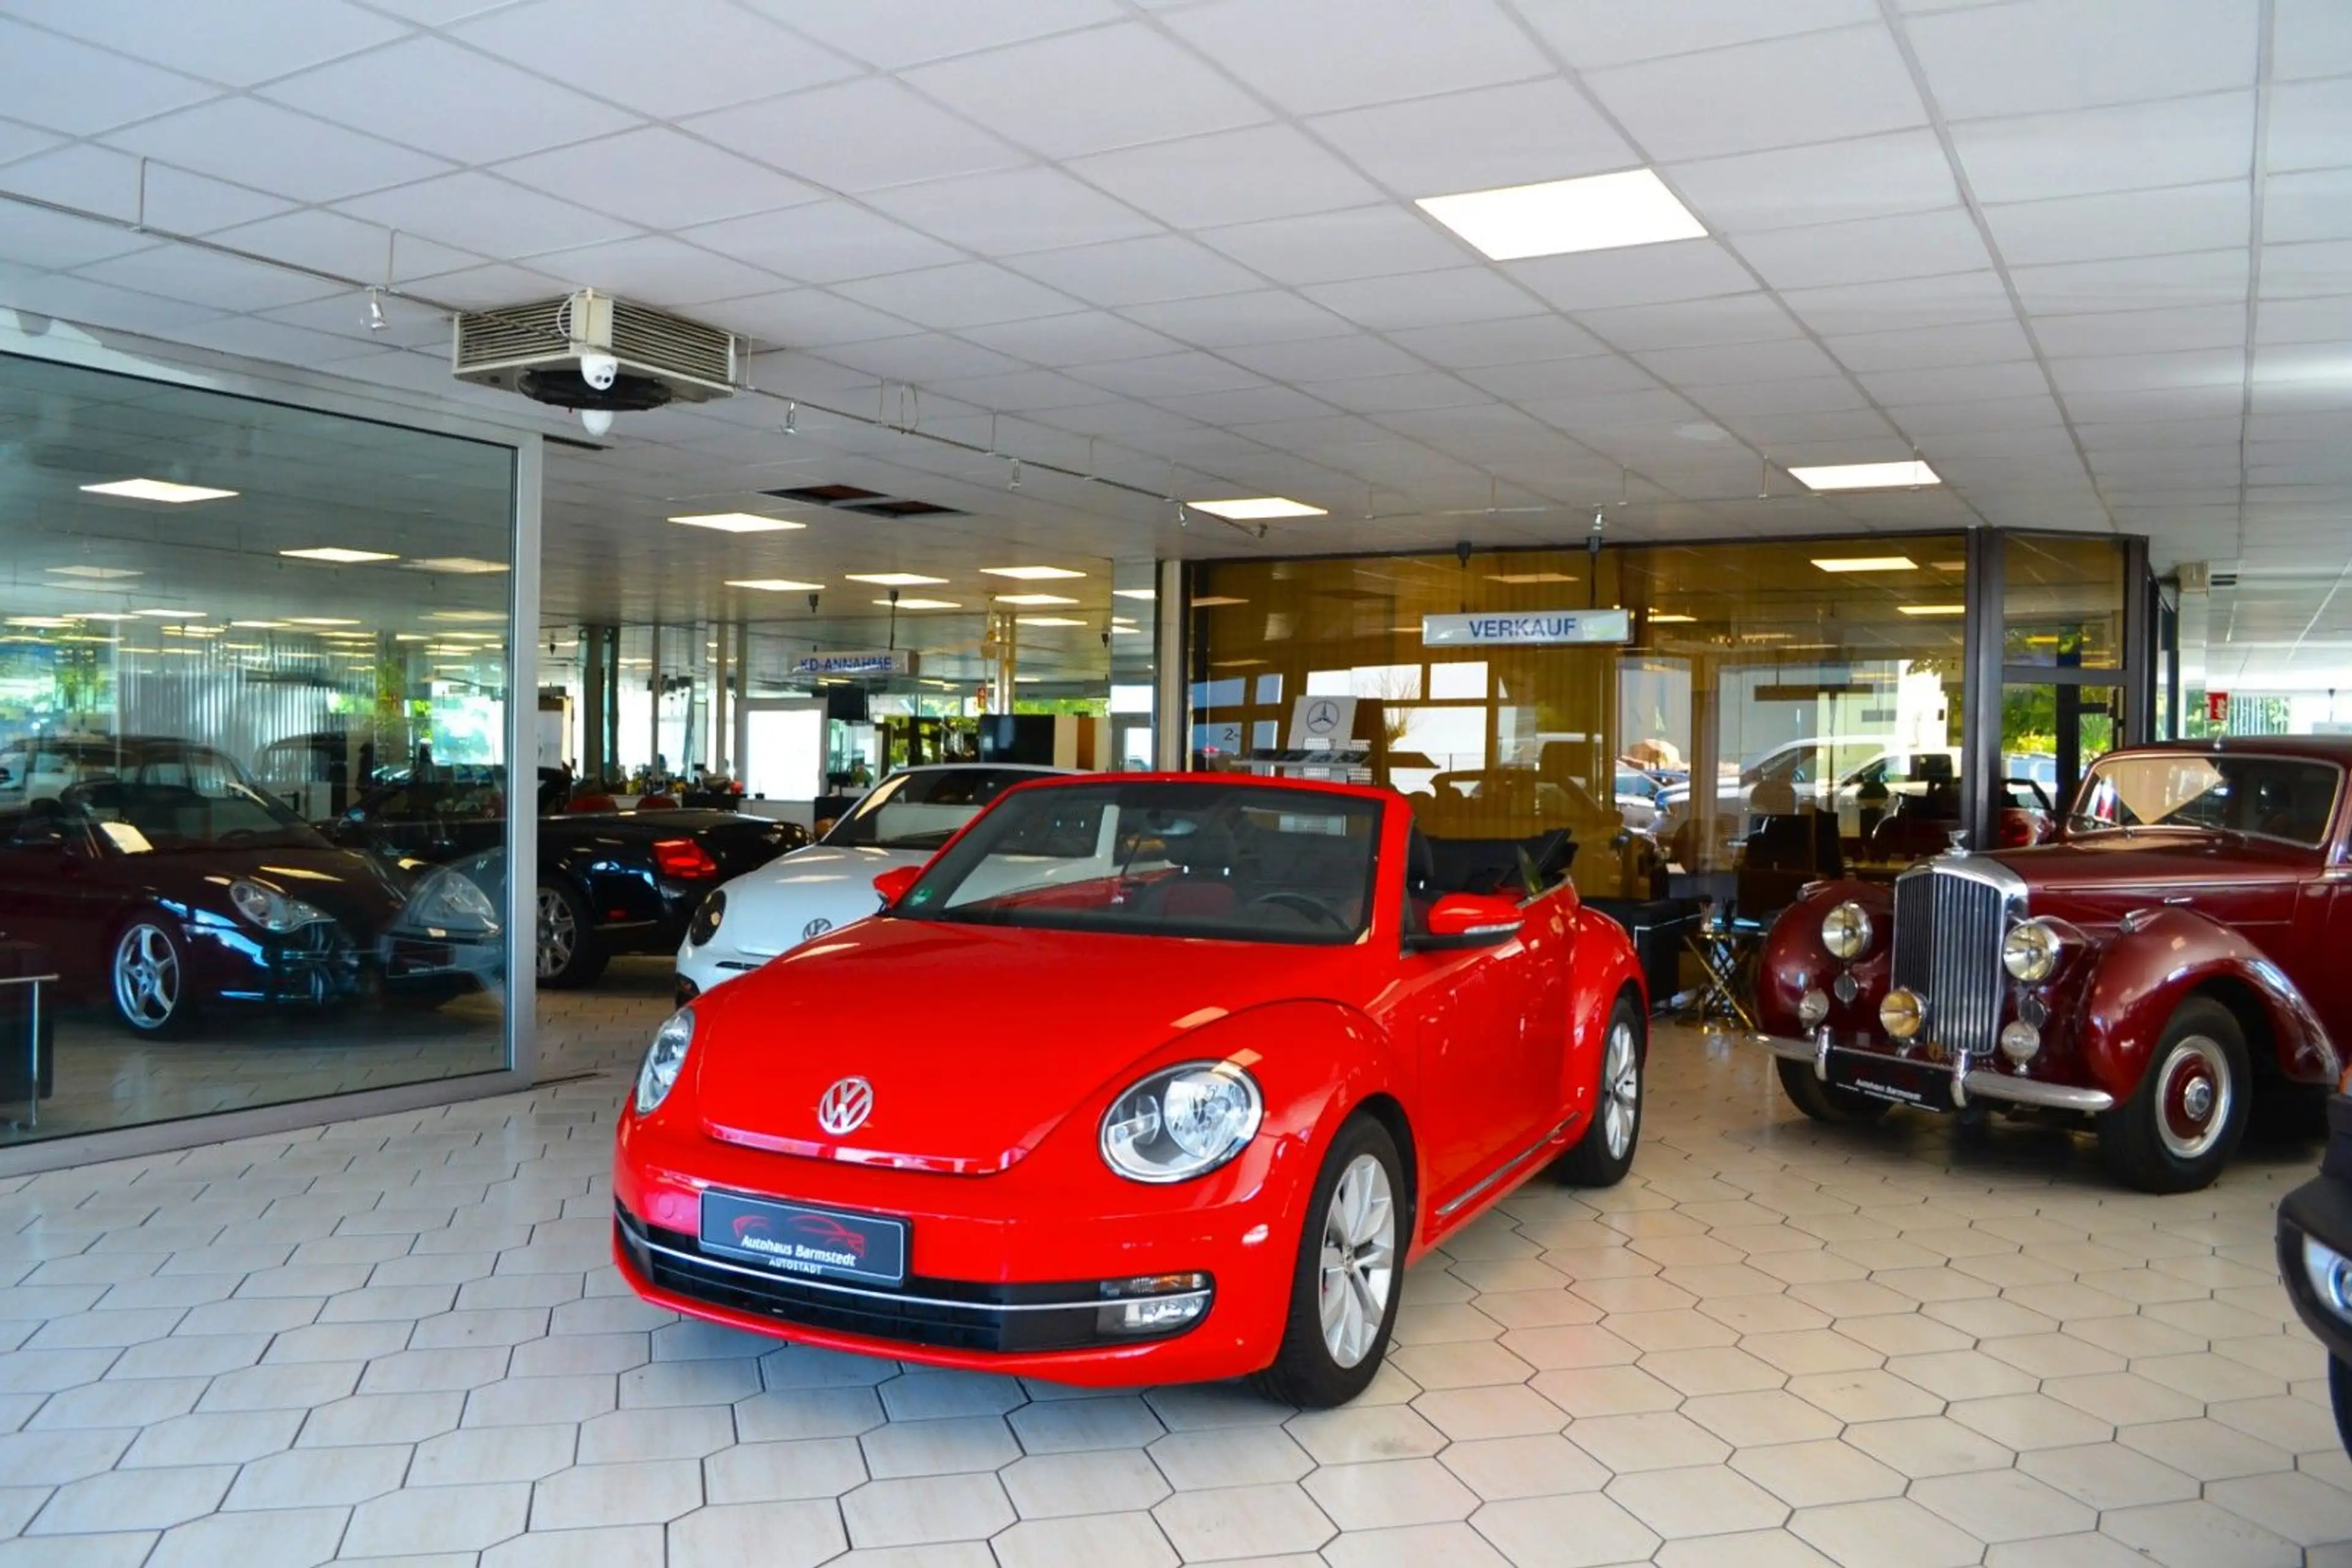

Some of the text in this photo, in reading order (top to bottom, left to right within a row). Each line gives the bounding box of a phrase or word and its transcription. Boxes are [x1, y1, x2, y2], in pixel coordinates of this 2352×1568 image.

[1469, 617, 1577, 638] VERKAUF
[820, 1076, 873, 1135] VW
[742, 1235, 856, 1267] Autohaus Barmstedt
[768, 1257, 823, 1275] AUTOSTADT
